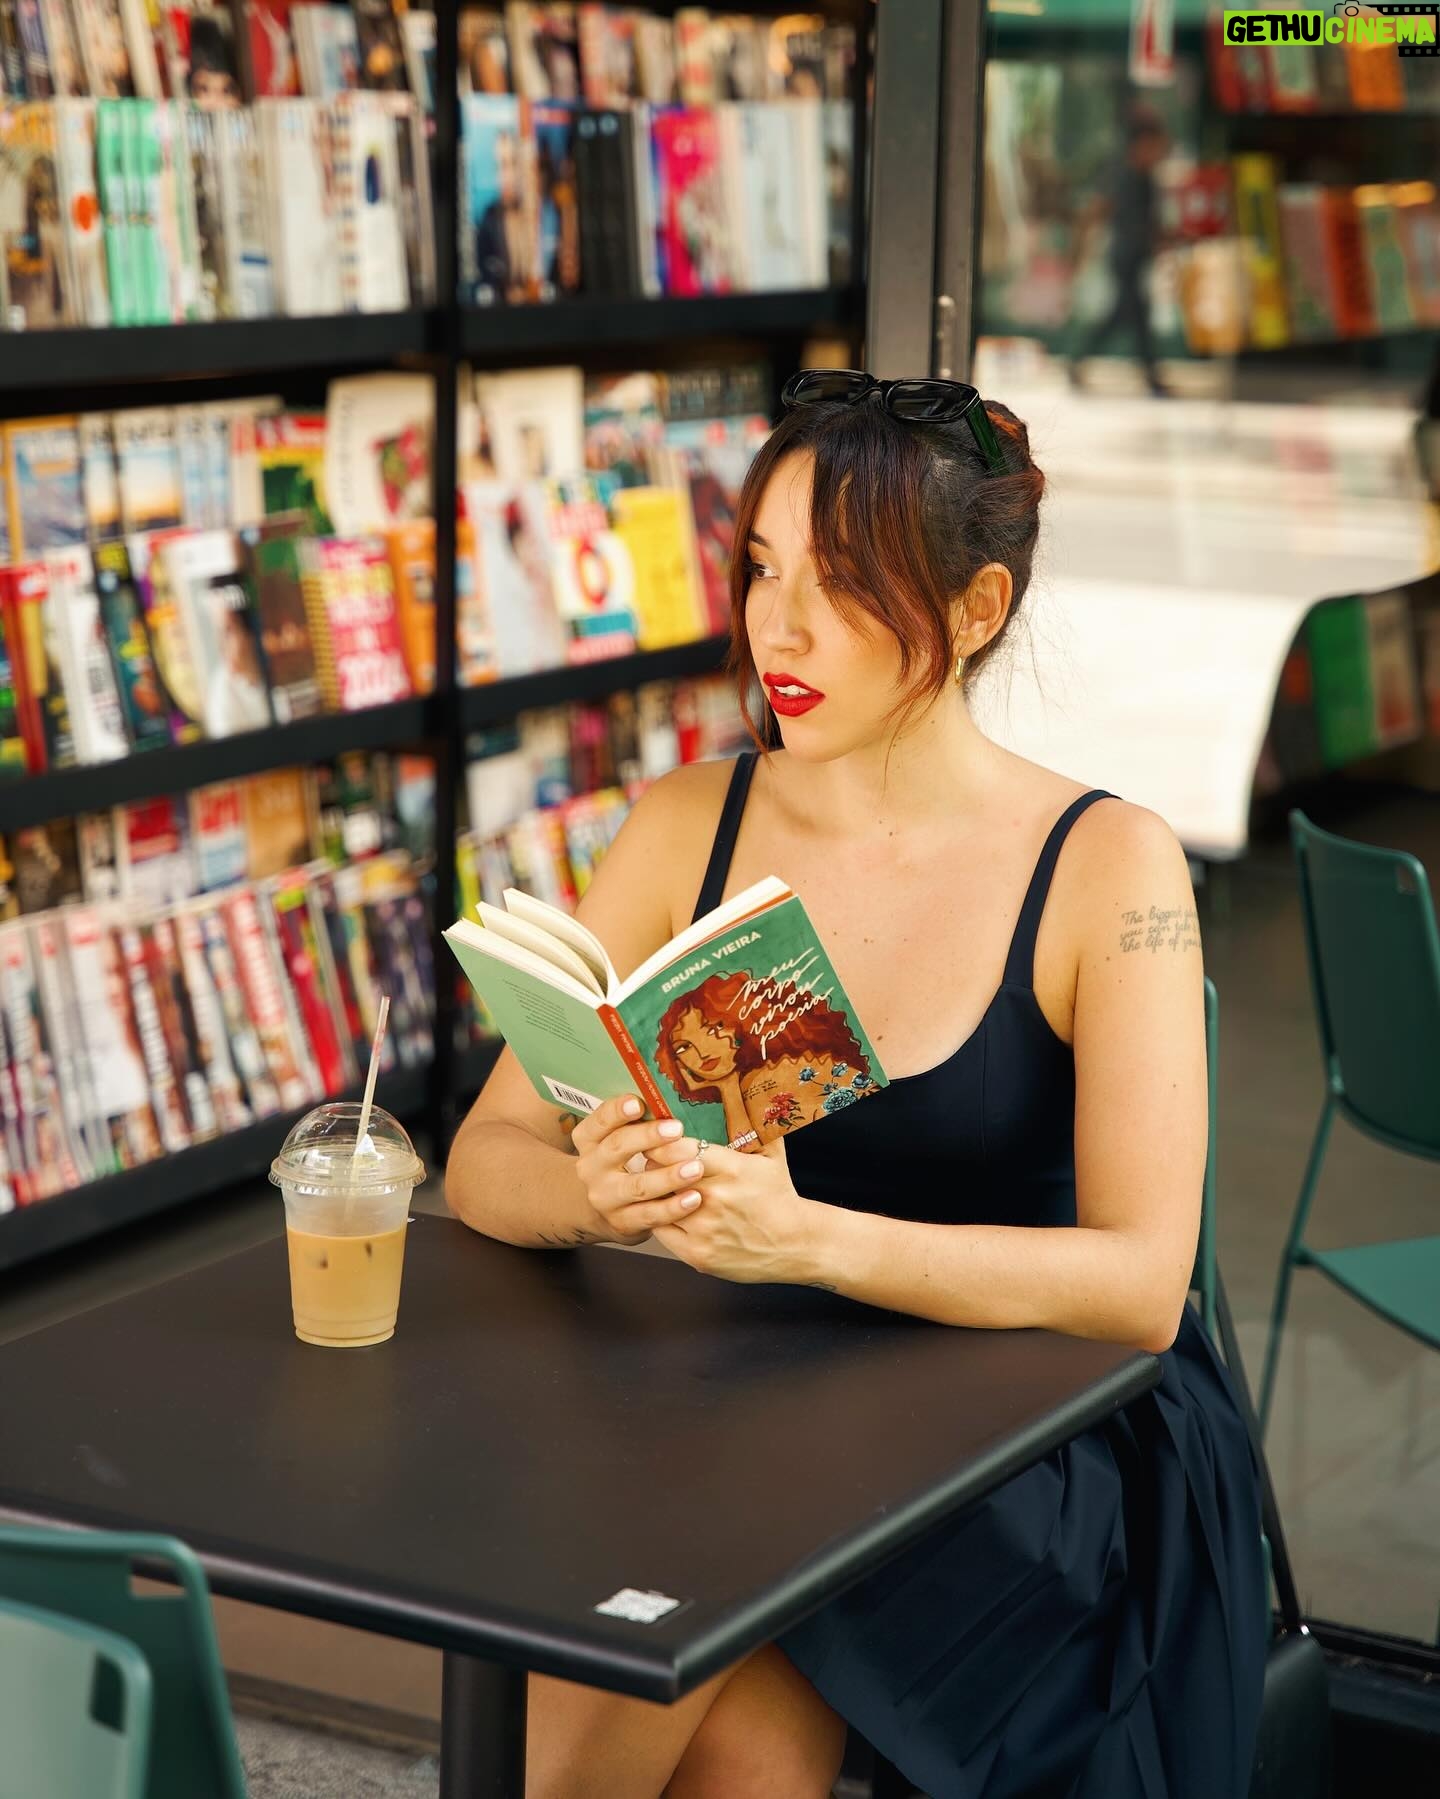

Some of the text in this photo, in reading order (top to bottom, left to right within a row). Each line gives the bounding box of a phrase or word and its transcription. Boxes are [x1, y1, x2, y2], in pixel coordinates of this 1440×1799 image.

[1121, 910, 1144, 926] The
[661, 931, 763, 993] BRUNA VIEIRA
[726, 946, 815, 1011] meu
[738, 955, 820, 1020] corpo
[749, 972, 824, 1035] virou
[760, 986, 835, 1060] poesia
